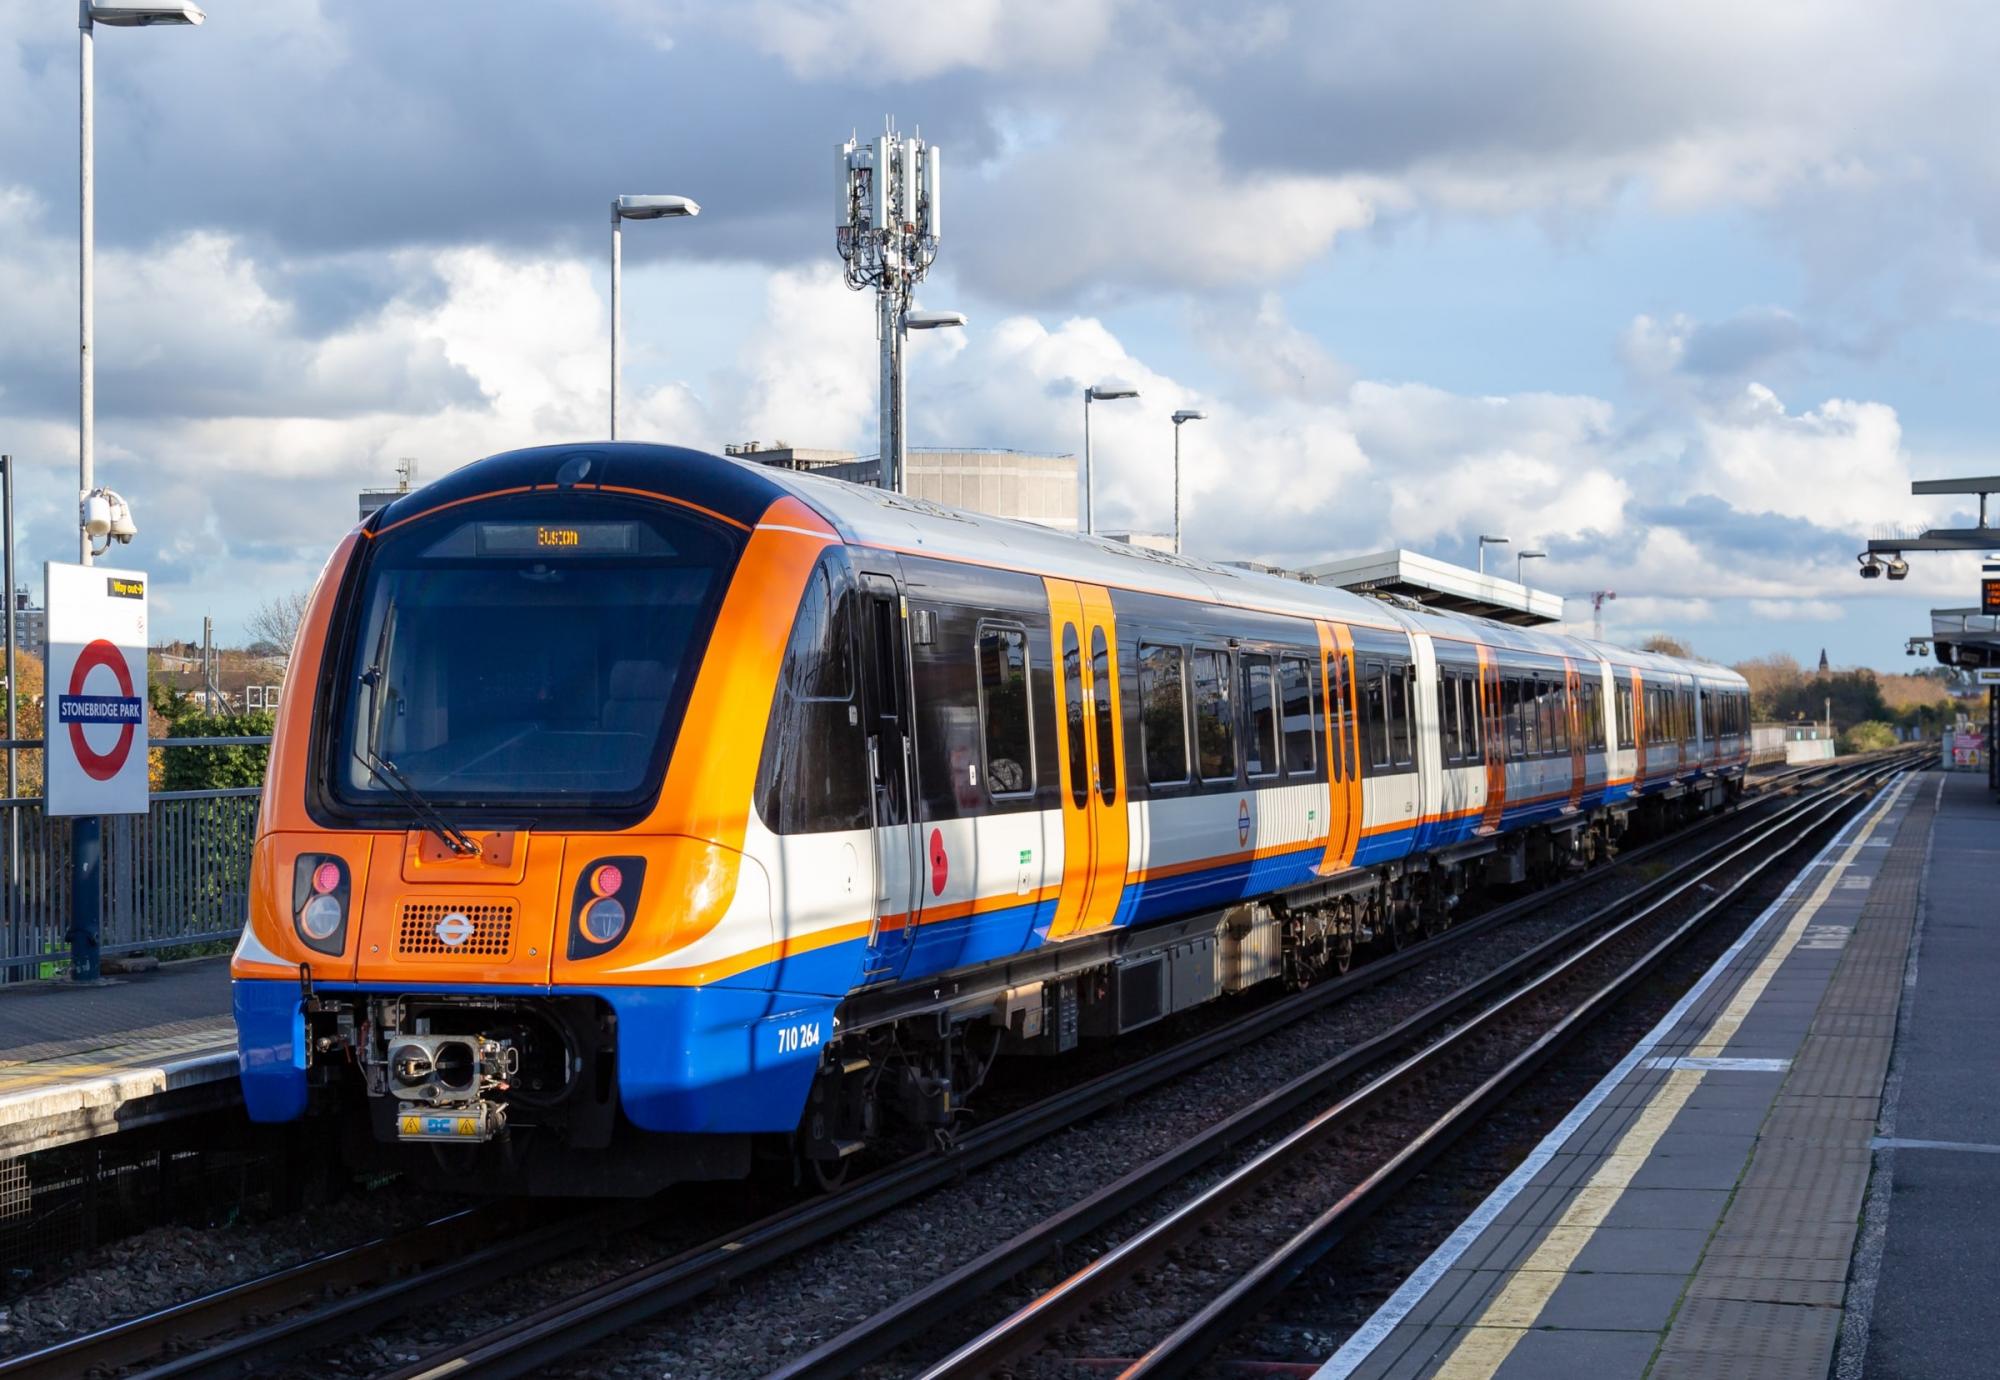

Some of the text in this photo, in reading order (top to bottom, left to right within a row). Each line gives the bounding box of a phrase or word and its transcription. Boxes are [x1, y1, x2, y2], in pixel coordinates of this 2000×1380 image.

[537, 527, 578, 545] Euston
[113, 579, 127, 595] Way
[61, 702, 140, 717] STONEBRIDGE PARK
[778, 1021, 820, 1054] 710 264
